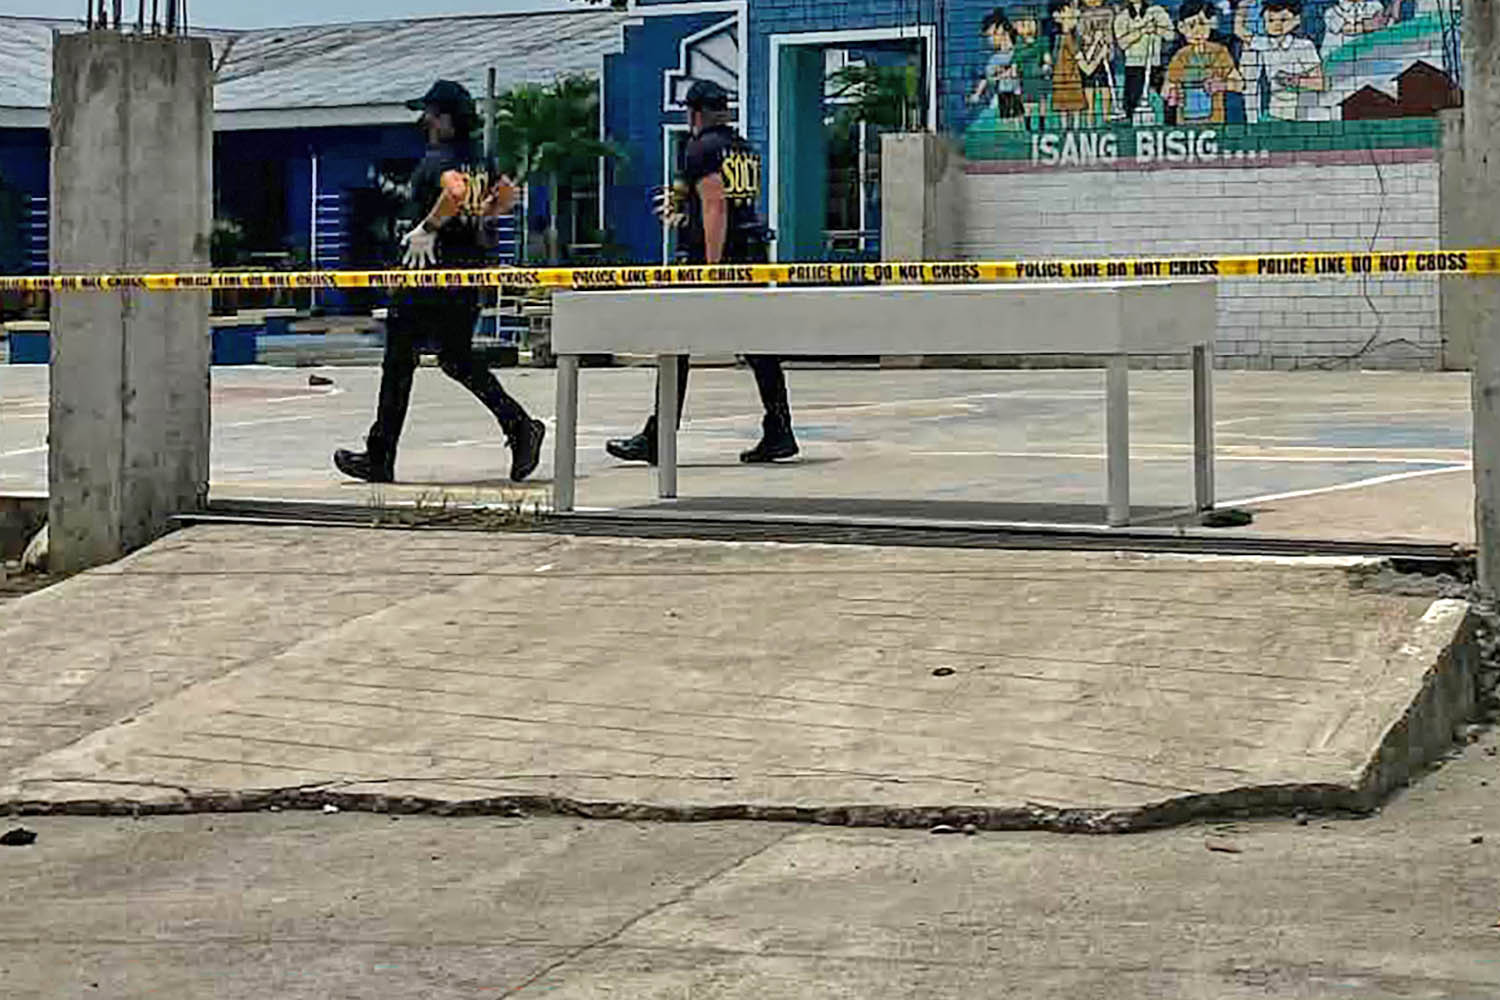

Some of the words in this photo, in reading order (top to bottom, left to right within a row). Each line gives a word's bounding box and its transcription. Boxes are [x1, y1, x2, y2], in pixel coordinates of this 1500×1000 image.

[1032, 131, 1118, 165] ISANG
[788, 266, 832, 280] POLICE
[874, 265, 892, 279] DO
[899, 265, 926, 278] NOT
[932, 264, 980, 278] CROSS
[1017, 263, 1064, 277] POLICE
[1070, 262, 1102, 277] LINE
[1107, 262, 1127, 276] DO
[1134, 261, 1163, 276] NOT
[1169, 260, 1218, 275] CROSS
[1257, 258, 1308, 275] POLICE
[1314, 256, 1346, 274] LINE
[1352, 256, 1373, 273] DO
[1379, 255, 1408, 272] NOT
[1416, 253, 1467, 271] CROSS
